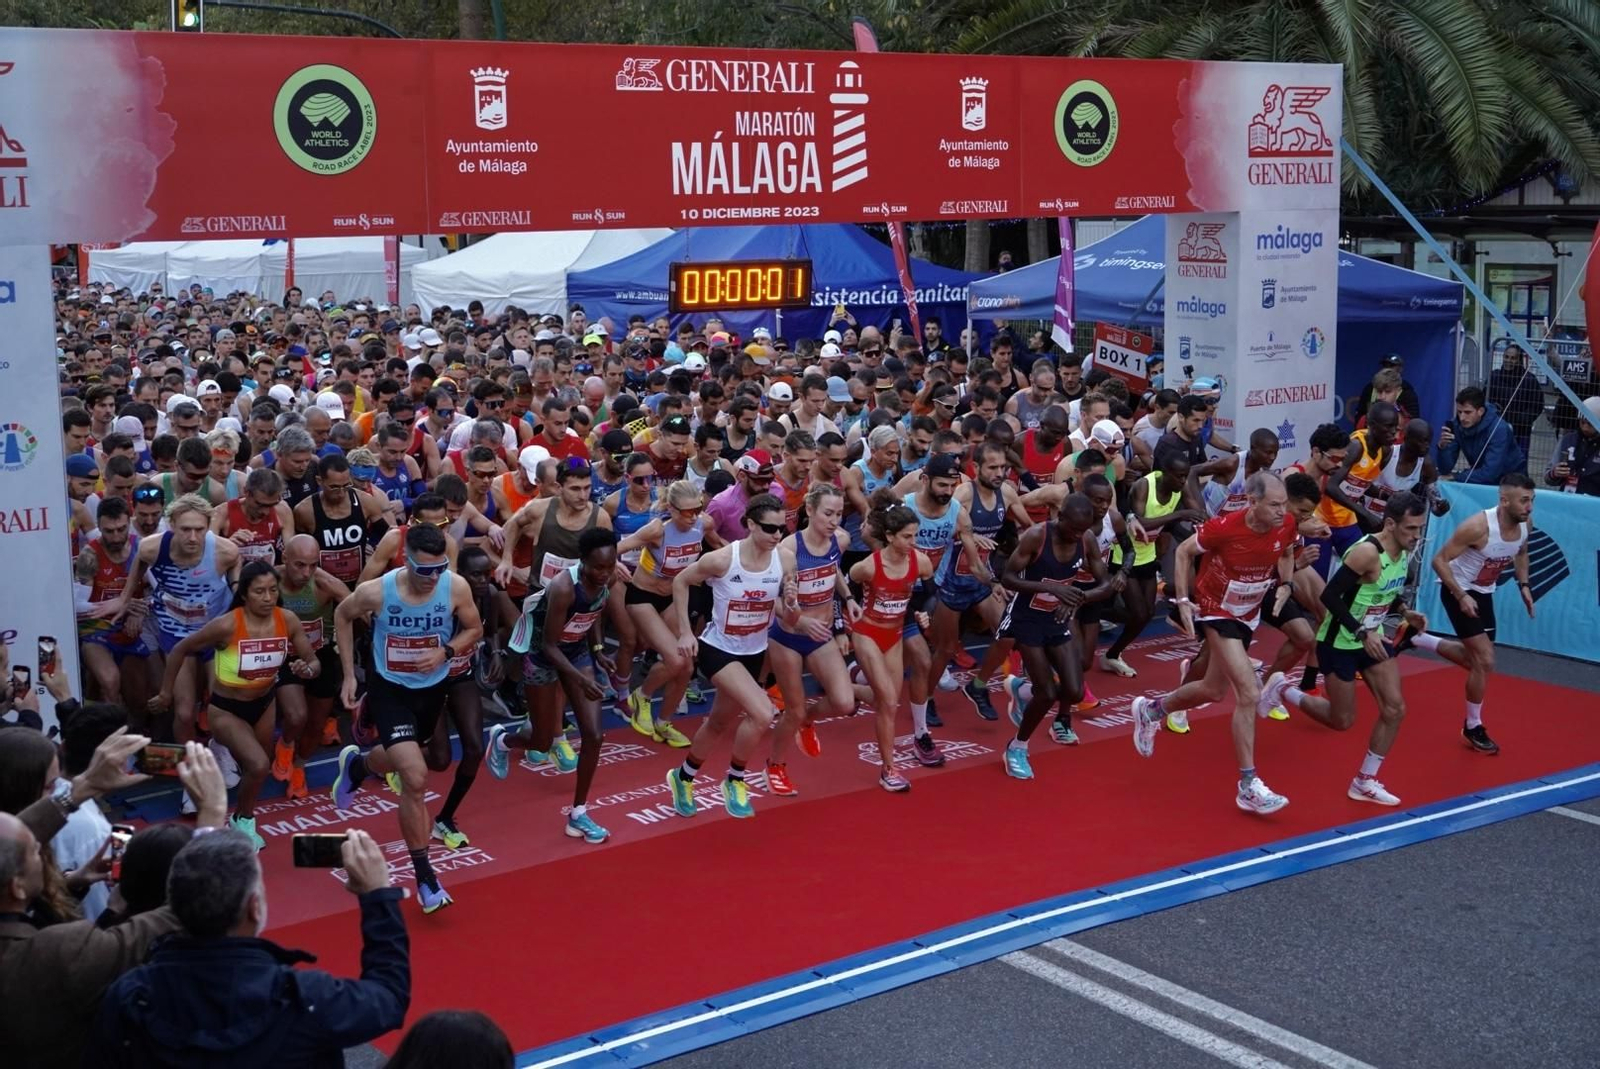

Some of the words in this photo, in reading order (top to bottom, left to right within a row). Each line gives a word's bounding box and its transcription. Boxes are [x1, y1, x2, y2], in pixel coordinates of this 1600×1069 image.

[666, 59, 815, 94] GENERALI
[364, 103, 373, 128] 2023
[735, 107, 815, 137] MARATÓN
[311, 130, 342, 139] WORLD
[304, 139, 349, 147] ATHLETICS
[356, 130, 373, 155] LABEL
[446, 138, 538, 156] Ayuntamiento
[939, 138, 1009, 154] Ayuntamiento
[312, 161, 337, 171] ROAD
[337, 153, 359, 168] RACE
[458, 159, 475, 173] de
[479, 158, 527, 175] Málaga
[672, 131, 823, 196] MÁLAGA
[948, 156, 961, 168] de
[963, 155, 1000, 170] Málaga
[1248, 162, 1333, 186] GENERALI
[862, 206, 880, 214] RUN
[891, 205, 907, 213] SUN
[955, 199, 1008, 214] GENERALI
[1039, 201, 1056, 209] RUN
[1064, 200, 1079, 208] SUN
[1129, 195, 1175, 209] GENERALI
[461, 210, 531, 227] GENERALI
[572, 212, 593, 221] RUN
[606, 211, 625, 220] SUN
[680, 208, 698, 220] 10
[702, 207, 781, 219] DICIEMBRE
[784, 206, 820, 217] 2023
[207, 215, 286, 232] GENERALI
[333, 217, 357, 227] RUN
[372, 216, 394, 226] SUN
[1177, 264, 1227, 279] GENERALI
[616, 290, 669, 302] www.ambuan
[903, 282, 969, 304] anitar
[1099, 345, 1129, 368] BOX
[1135, 358, 1142, 372] 1
[1566, 361, 1585, 373] AMS
[1265, 383, 1327, 406] GENERALI
[323, 524, 363, 547] MO
[812, 580, 825, 588] F34
[388, 612, 443, 631] nerja
[254, 655, 272, 663] PILA
[260, 799, 399, 836] MÁLAGA
